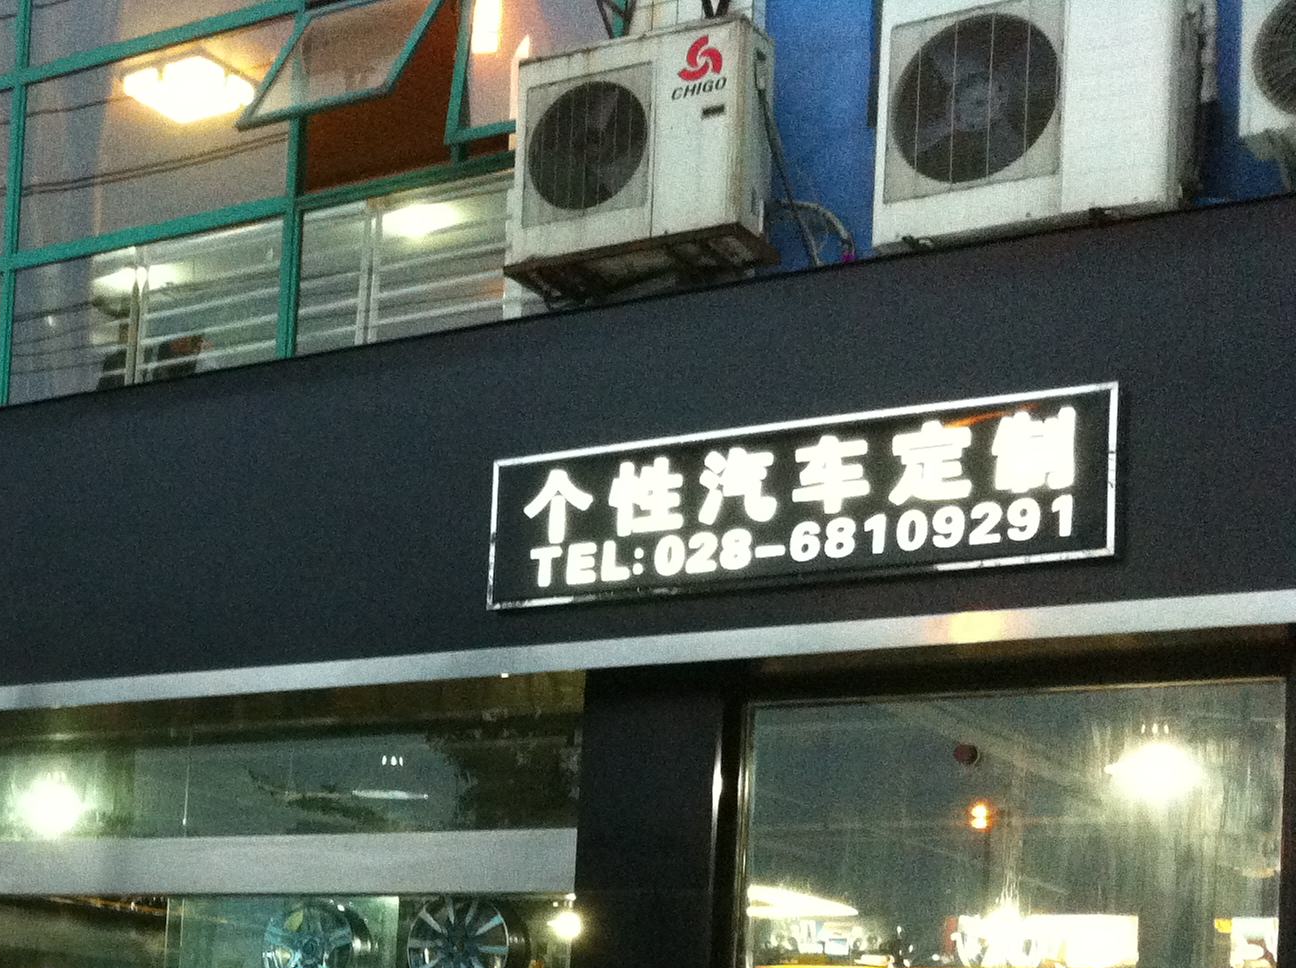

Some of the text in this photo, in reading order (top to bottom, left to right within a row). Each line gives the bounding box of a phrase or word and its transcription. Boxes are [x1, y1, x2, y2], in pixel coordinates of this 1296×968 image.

[671, 77, 727, 100] CHIGO
[523, 406, 1077, 545] 个性汽车定制
[530, 494, 1075, 588] TEL:028-68109291
